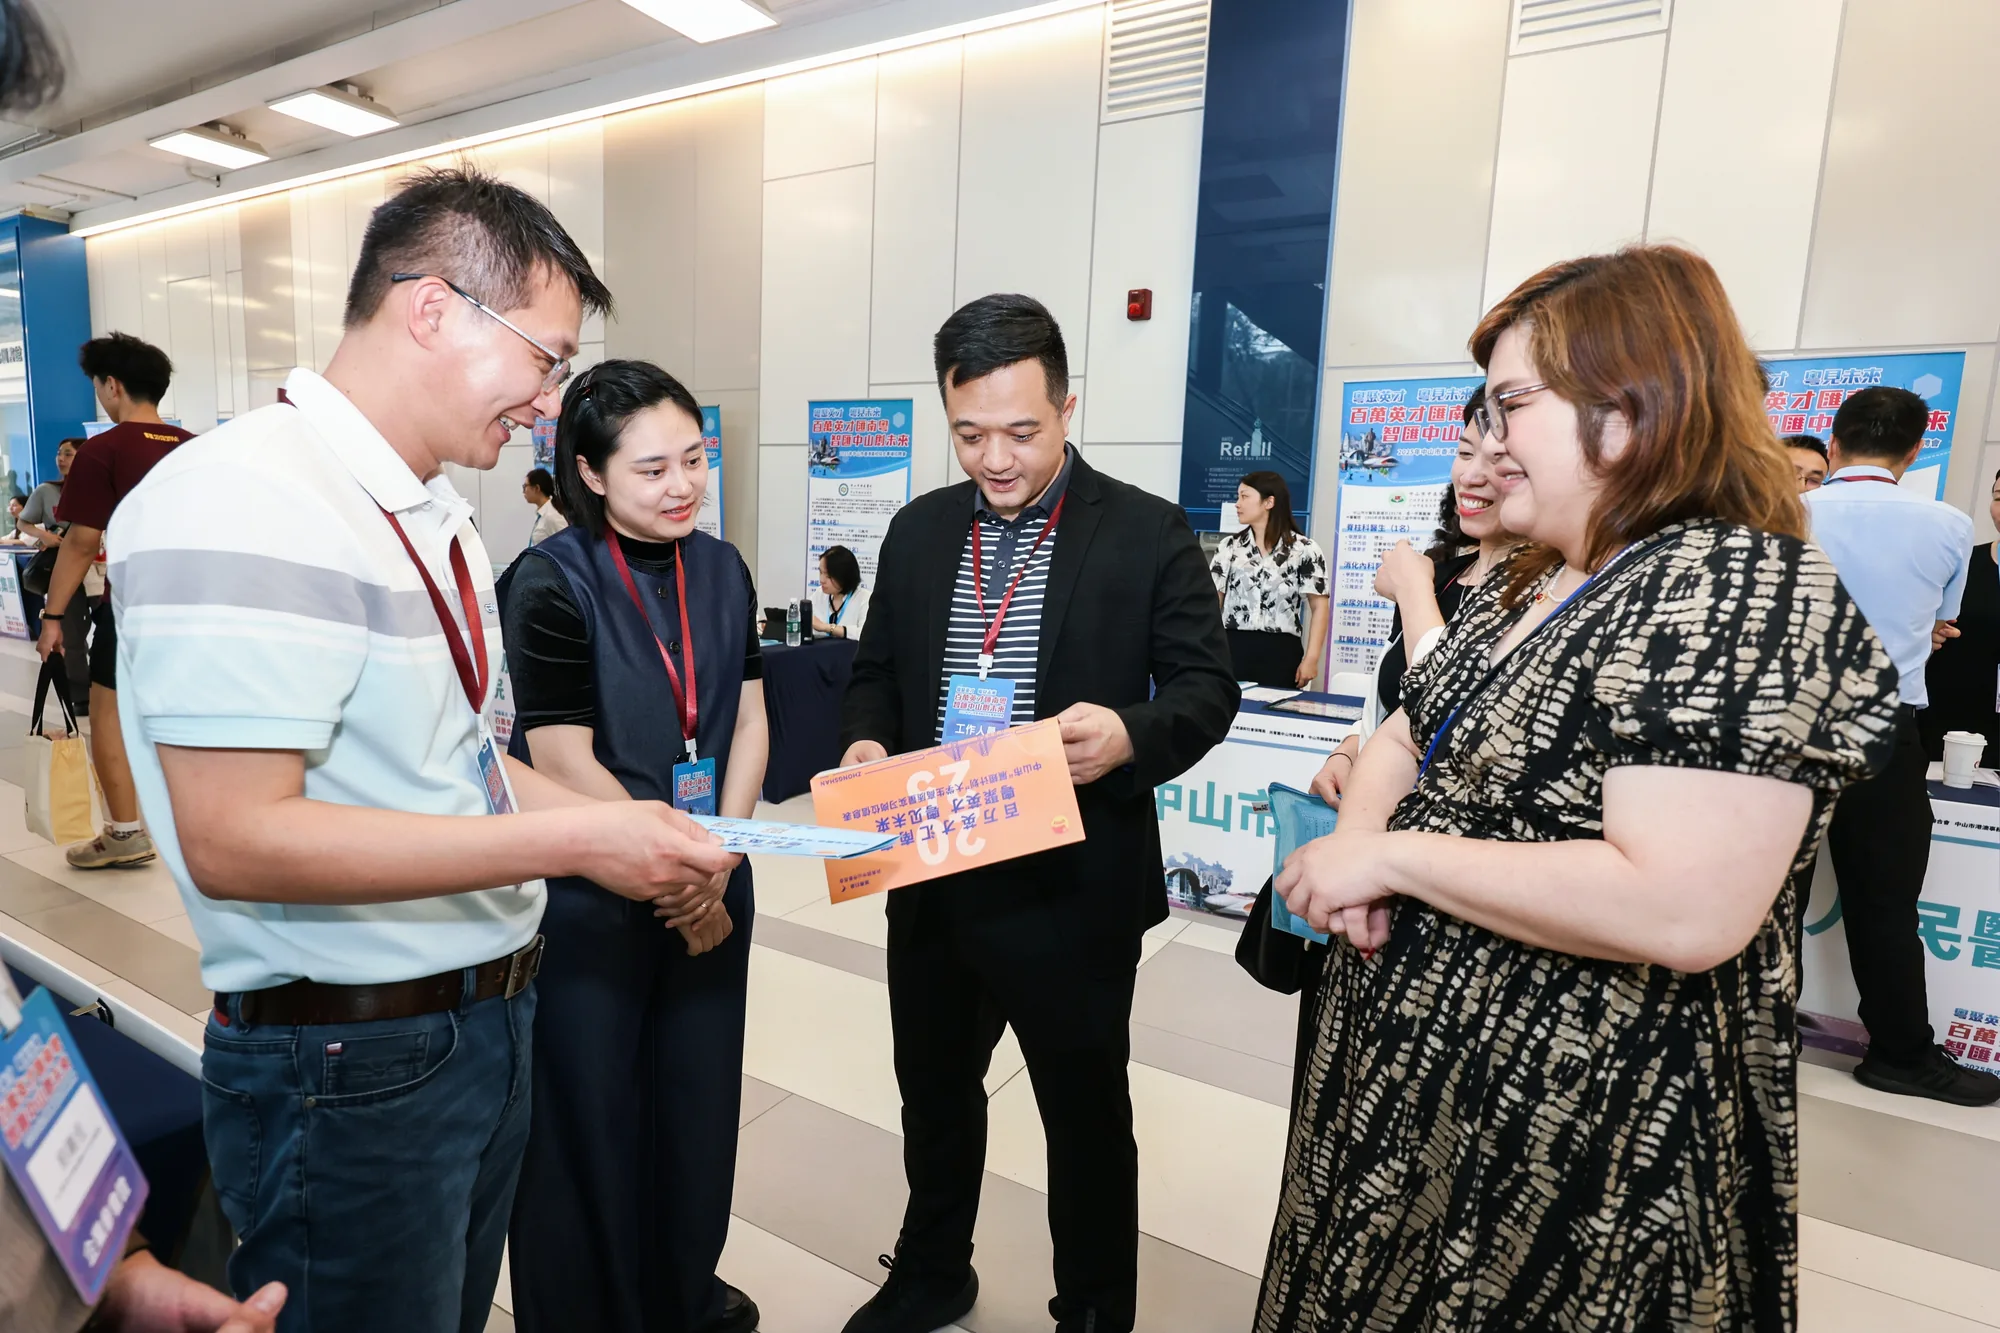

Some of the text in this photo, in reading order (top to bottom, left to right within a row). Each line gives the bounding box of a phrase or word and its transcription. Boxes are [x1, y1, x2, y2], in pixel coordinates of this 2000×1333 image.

[1804, 367, 1883, 386] 粵見未來
[1349, 404, 1466, 424] 百萬英才匯南
[812, 419, 889, 432] 百萬英才匯南粵
[1382, 424, 1462, 443] 智匯中山
[830, 433, 910, 447] 智匯中山創未來
[820, 771, 862, 787] ZHONGSHAN
[875, 784, 1016, 834] 粤聚英才 粤见未来
[1155, 781, 1275, 838] 中山市
[879, 802, 1020, 851] 百万英才汇南
